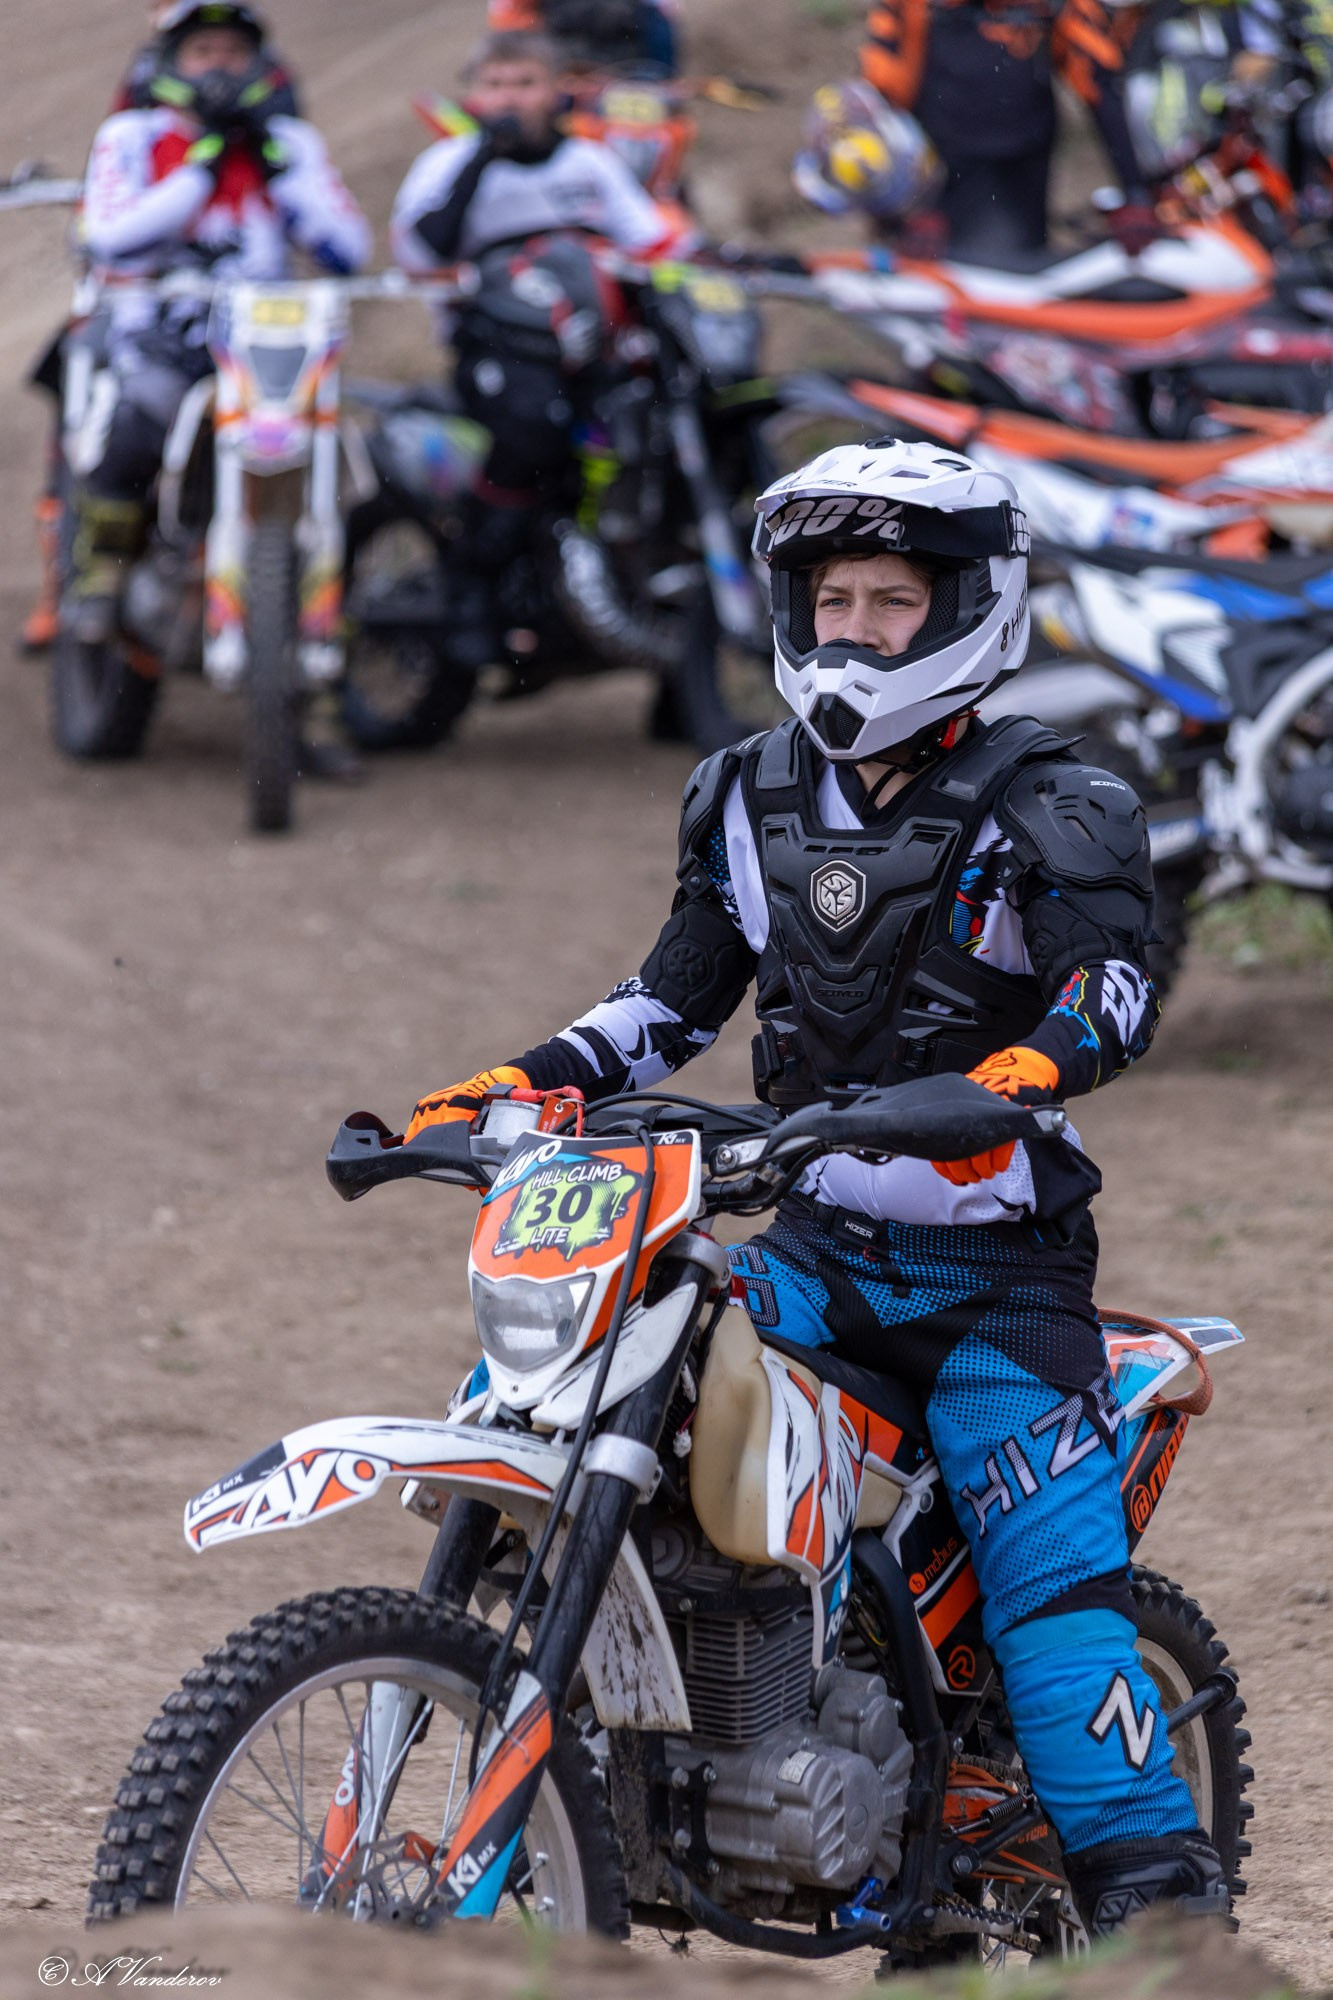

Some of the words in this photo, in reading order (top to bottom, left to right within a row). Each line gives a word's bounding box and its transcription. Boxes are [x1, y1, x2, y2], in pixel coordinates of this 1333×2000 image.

[489, 1139, 562, 1195] KAYO
[531, 1170, 563, 1192] HILL
[566, 1163, 623, 1184] CLIMB
[525, 1183, 594, 1230] 30
[529, 1226, 571, 1246] LITE
[845, 1220, 874, 1240] HIZER
[924, 1536, 958, 1582] mobius
[477, 1841, 498, 1867] MX
